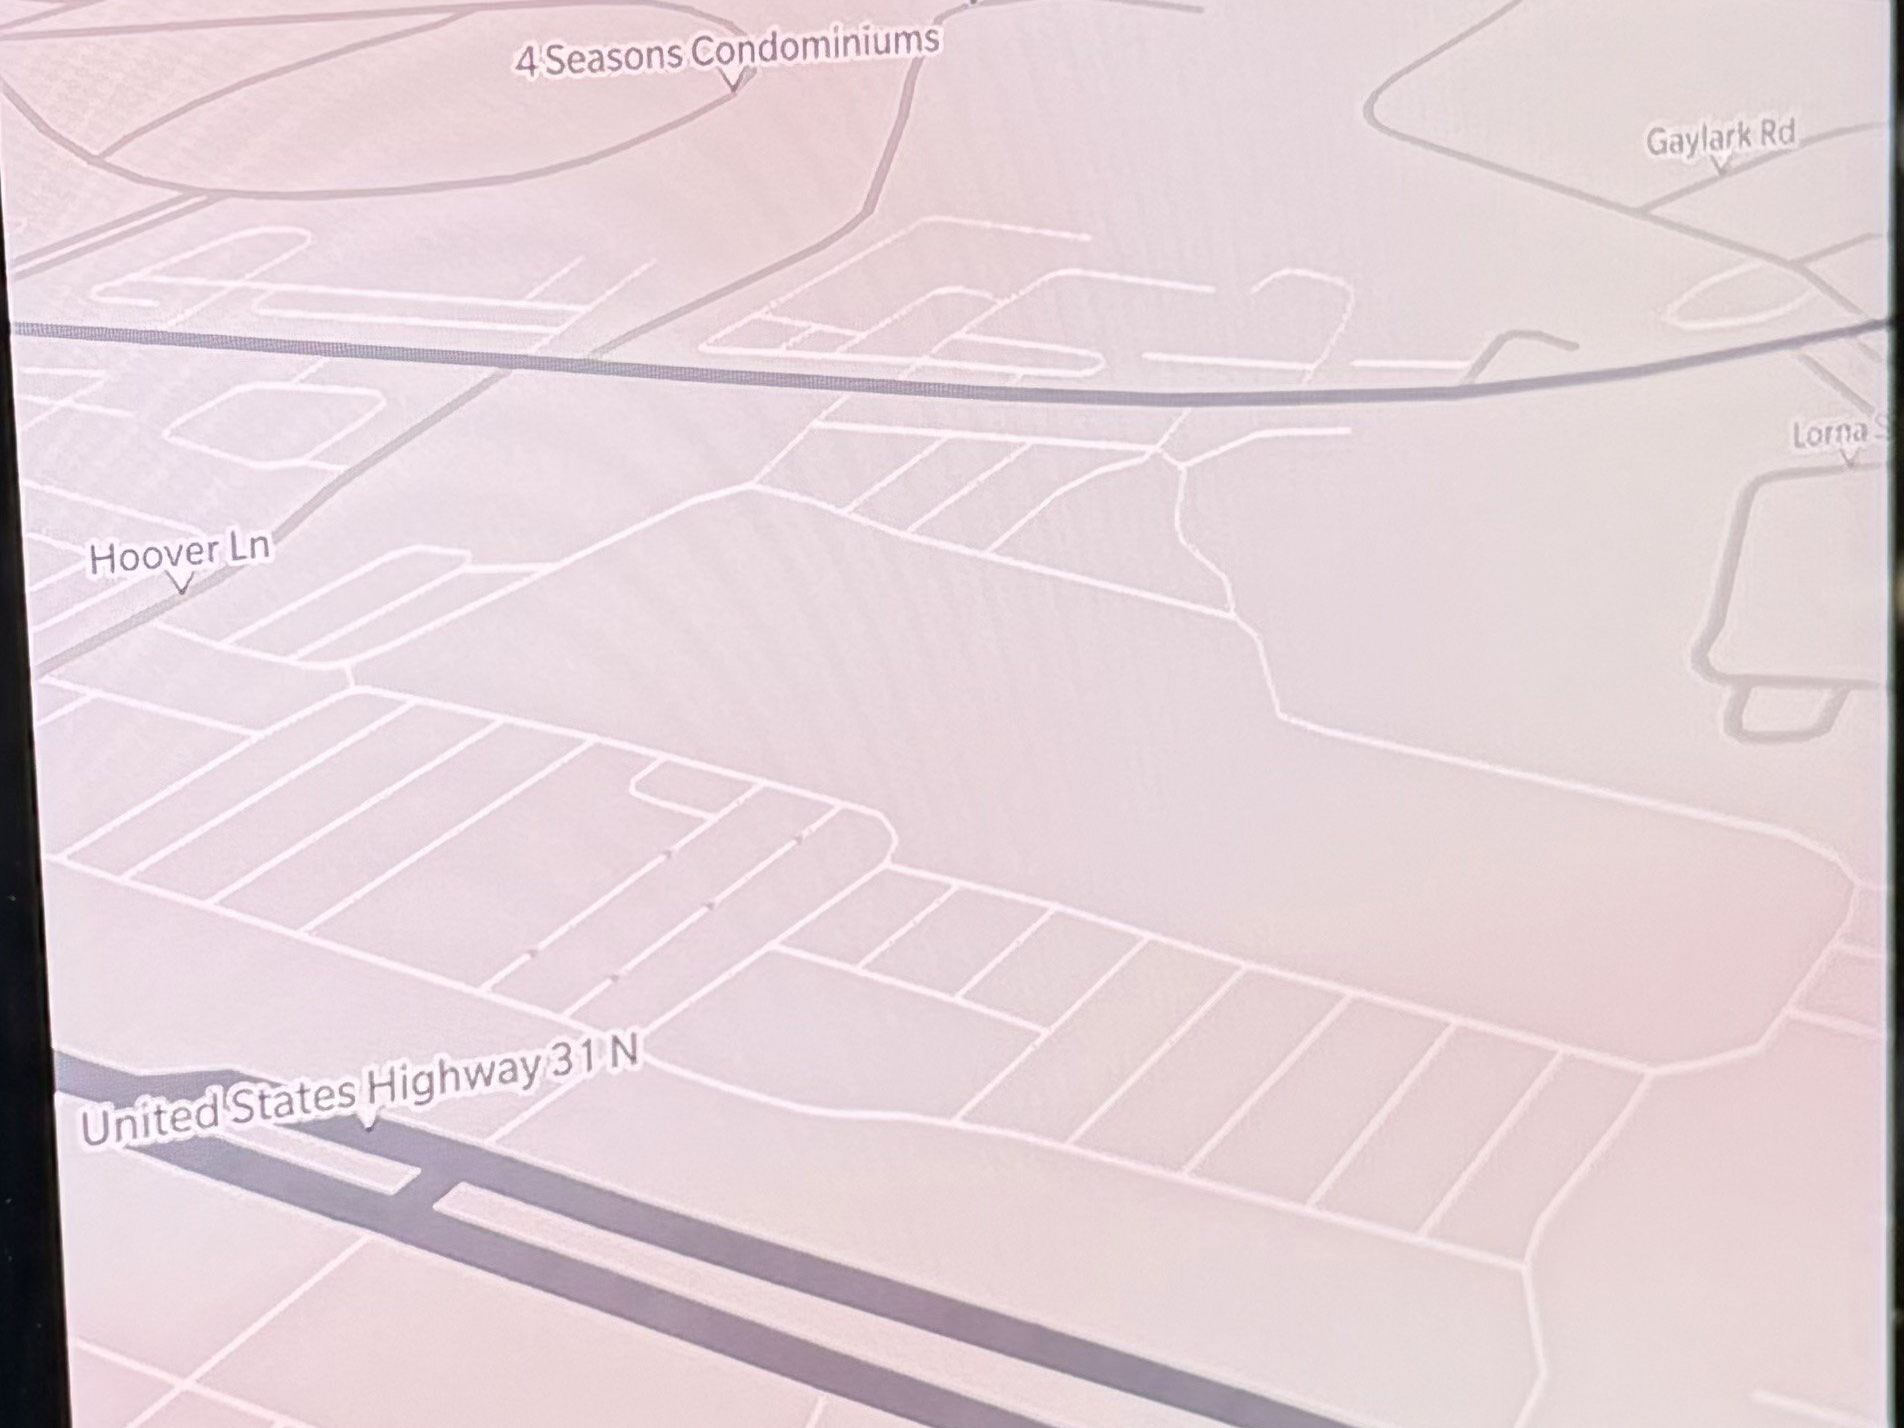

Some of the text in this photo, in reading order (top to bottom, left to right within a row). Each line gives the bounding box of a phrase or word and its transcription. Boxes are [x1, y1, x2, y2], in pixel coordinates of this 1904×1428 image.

[514, 22, 941, 77] 4 Seasons Condominiums
[1646, 117, 1797, 161] Gaylark Rd
[1793, 421, 1869, 449] Lorna
[90, 530, 270, 575] Hoover Ln
[81, 1032, 640, 1148] United States Highway 31 N
